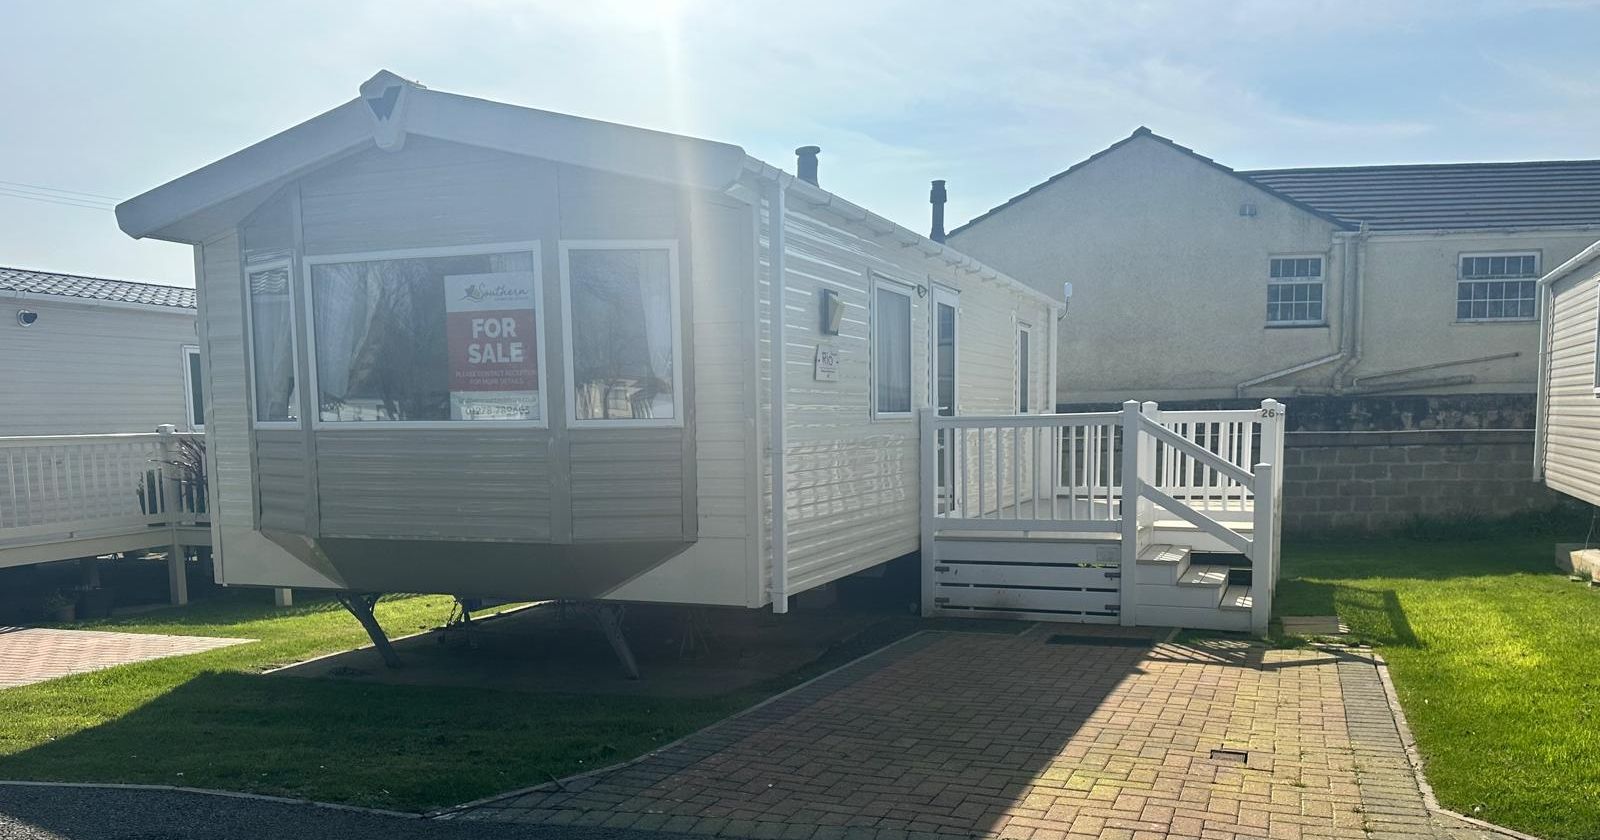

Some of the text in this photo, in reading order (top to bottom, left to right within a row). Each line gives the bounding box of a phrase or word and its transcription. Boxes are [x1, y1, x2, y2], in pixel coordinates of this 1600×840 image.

[479, 282, 529, 298] Southern
[472, 317, 517, 339] FOR
[468, 342, 524, 364] SALE
[1262, 409, 1275, 418] 26
